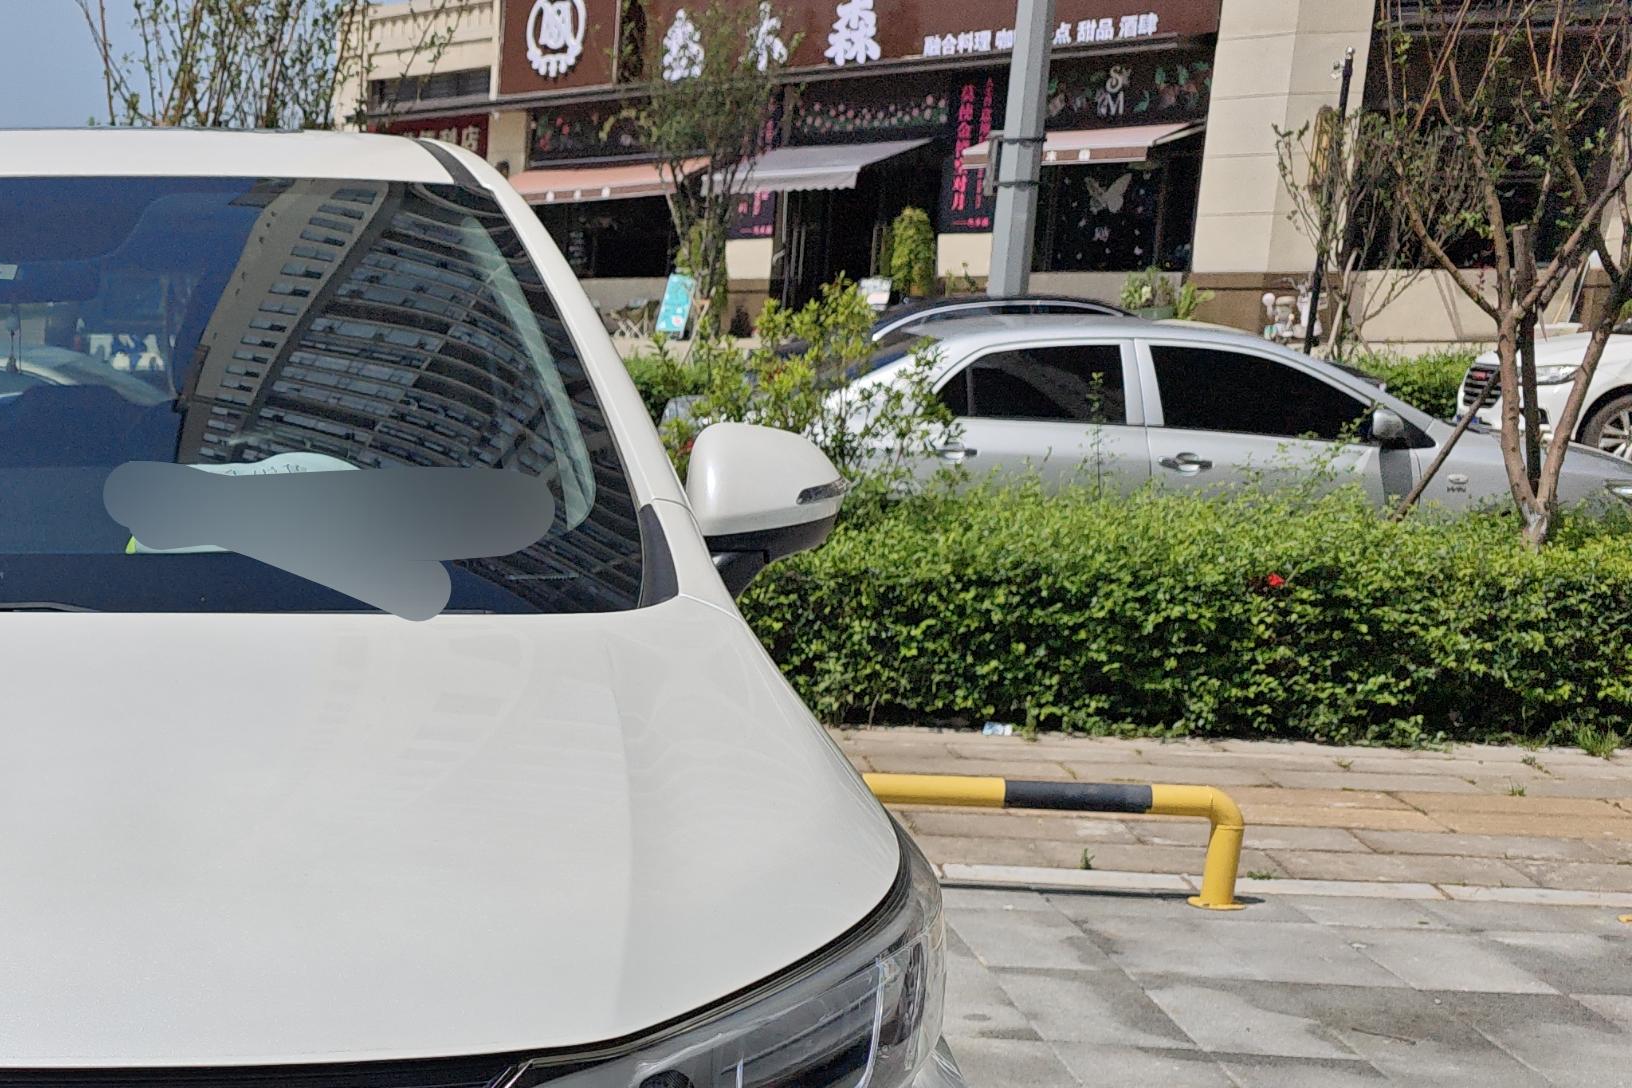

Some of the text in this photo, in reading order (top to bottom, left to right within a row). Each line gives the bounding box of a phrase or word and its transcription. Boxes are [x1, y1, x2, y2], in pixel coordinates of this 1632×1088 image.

[923, 30, 992, 57] 融合料理
[1077, 18, 1115, 43] 甜品
